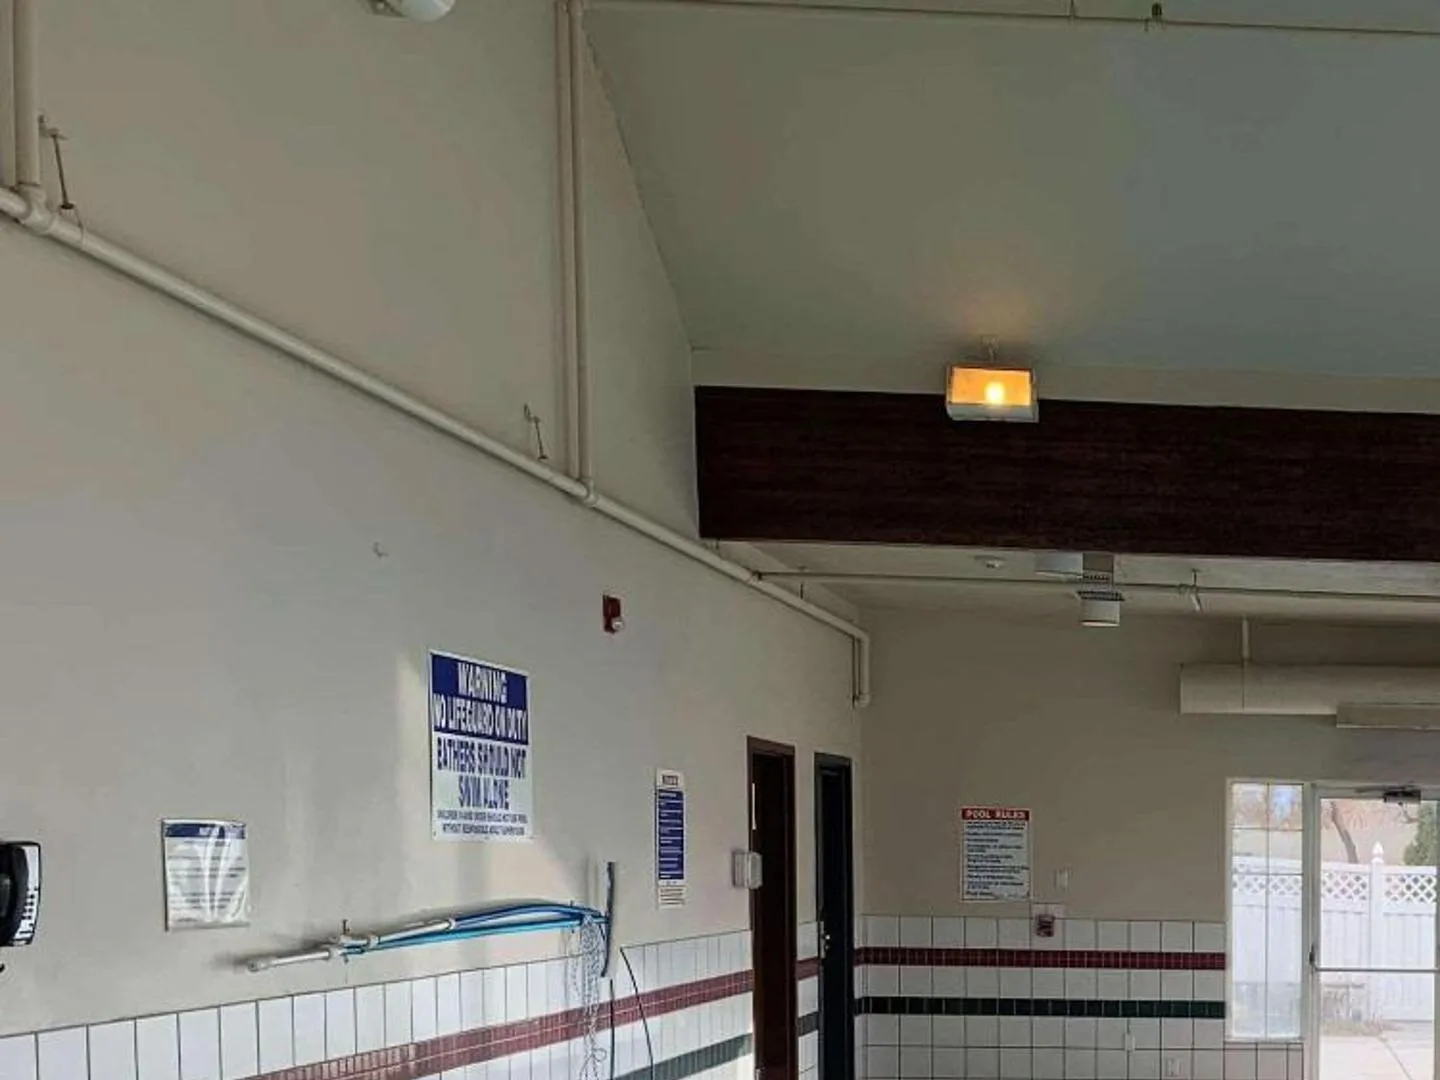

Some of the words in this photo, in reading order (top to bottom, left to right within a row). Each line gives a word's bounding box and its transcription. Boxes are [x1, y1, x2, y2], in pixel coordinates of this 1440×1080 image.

[458, 662, 507, 704] WARNING
[447, 696, 494, 736] LIFEGUARD
[437, 737, 475, 773] BATHERS
[965, 810, 992, 819] POOL
